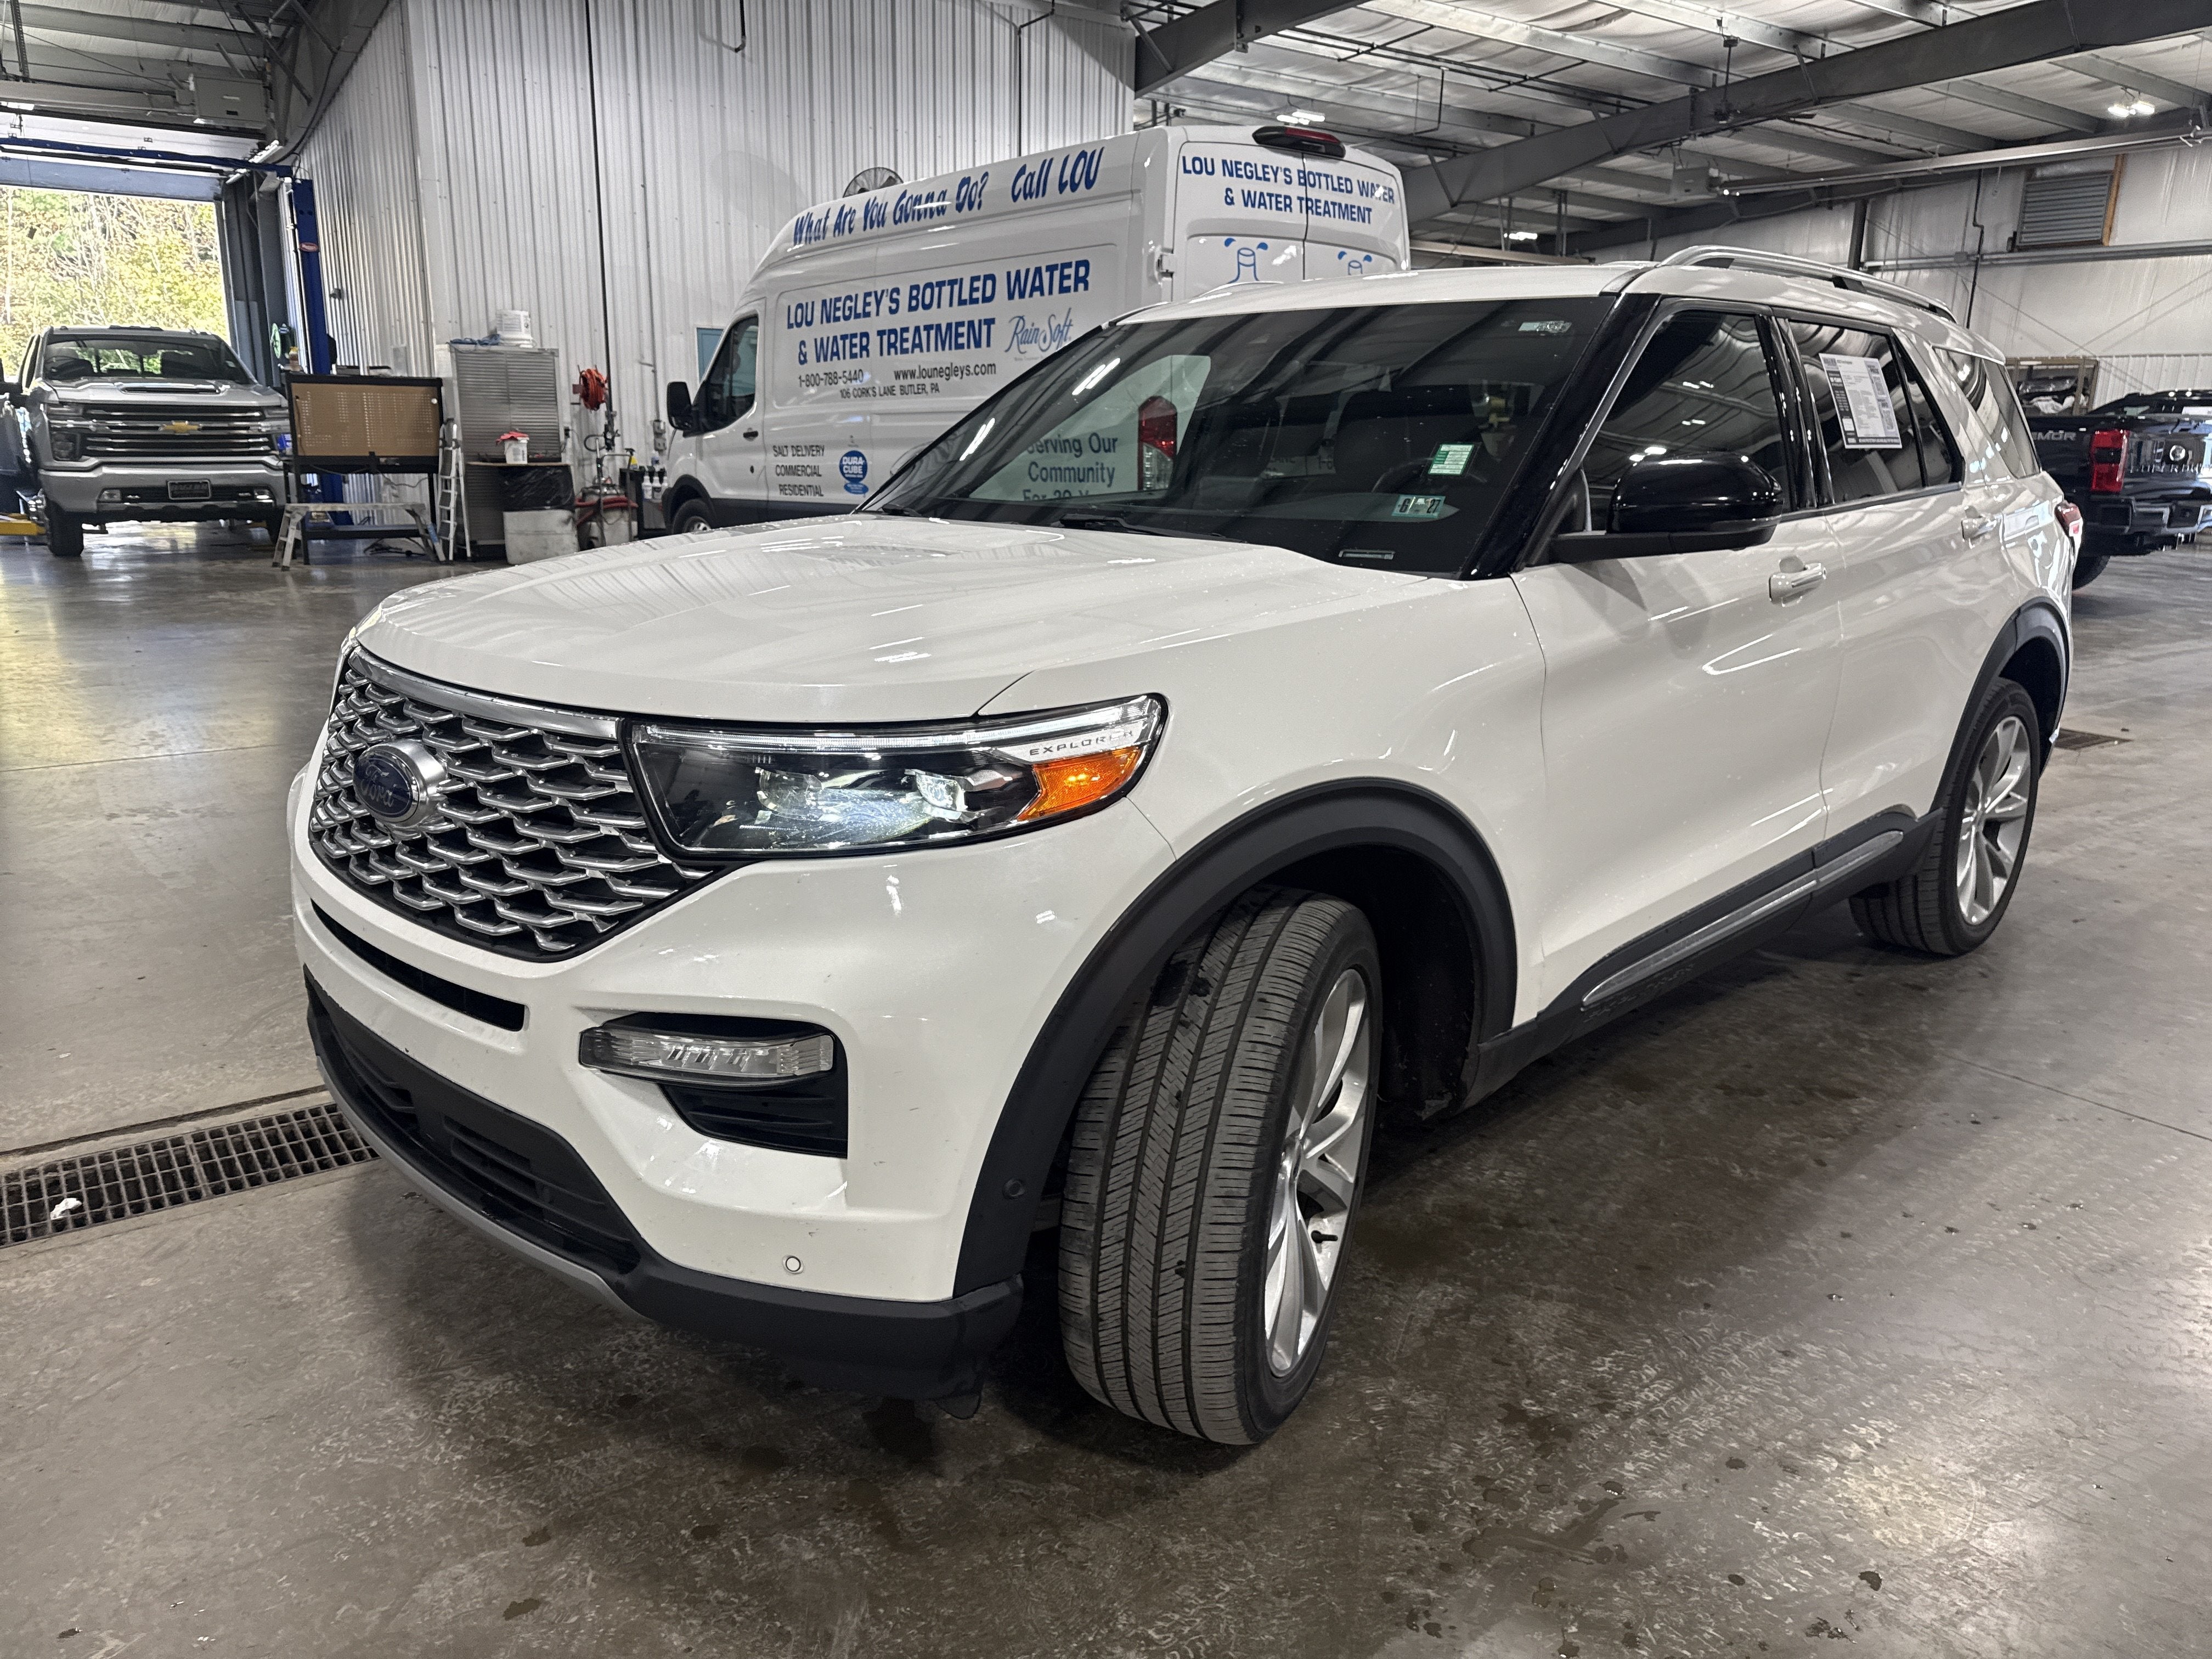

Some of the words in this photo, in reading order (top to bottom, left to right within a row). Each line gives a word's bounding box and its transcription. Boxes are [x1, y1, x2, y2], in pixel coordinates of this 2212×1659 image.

[1182, 156, 1215, 176] LOU
[1222, 159, 1292, 185] NEGLEY'S
[1297, 169, 1353, 194] BOTTLED
[1357, 179, 1395, 204] WATER
[793, 207, 831, 245] What
[833, 204, 855, 238] Are
[862, 195, 888, 232] You
[893, 188, 948, 225] Gonna
[956, 171, 989, 213] Do?
[1011, 157, 1053, 203] Call
[1058, 146, 1105, 195] LOU
[1224, 187, 1234, 206] &
[1242, 189, 1293, 213] WATER
[1297, 196, 1372, 224] TREATMENT
[787, 301, 815, 329] LOU
[820, 287, 900, 325] NEGLEY'S
[907, 273, 997, 313] BOTTLED
[1006, 259, 1090, 301] WATER
[798, 340, 808, 365] &
[815, 331, 870, 364] WATER
[877, 318, 996, 357] TREATMENT
[798, 369, 864, 387] 1-800-788-5440
[894, 362, 997, 381] www.lounegleys.com
[851, 386, 877, 398] CORK'S
[879, 385, 896, 396] LANE
[900, 383, 929, 396] BUTLER,
[930, 382, 940, 393] PA
[772, 445, 789, 457] SALT
[791, 445, 825, 457] DELIVERY
[1088, 432, 1118, 453] Our
[843, 456, 865, 465] DURA-
[843, 465, 863, 474] CUBE
[775, 464, 822, 477] COMMERCIAL
[1028, 461, 1115, 488] Community
[778, 483, 824, 496] RESIDENTIAL
[1426, 499, 1441, 514] 27
